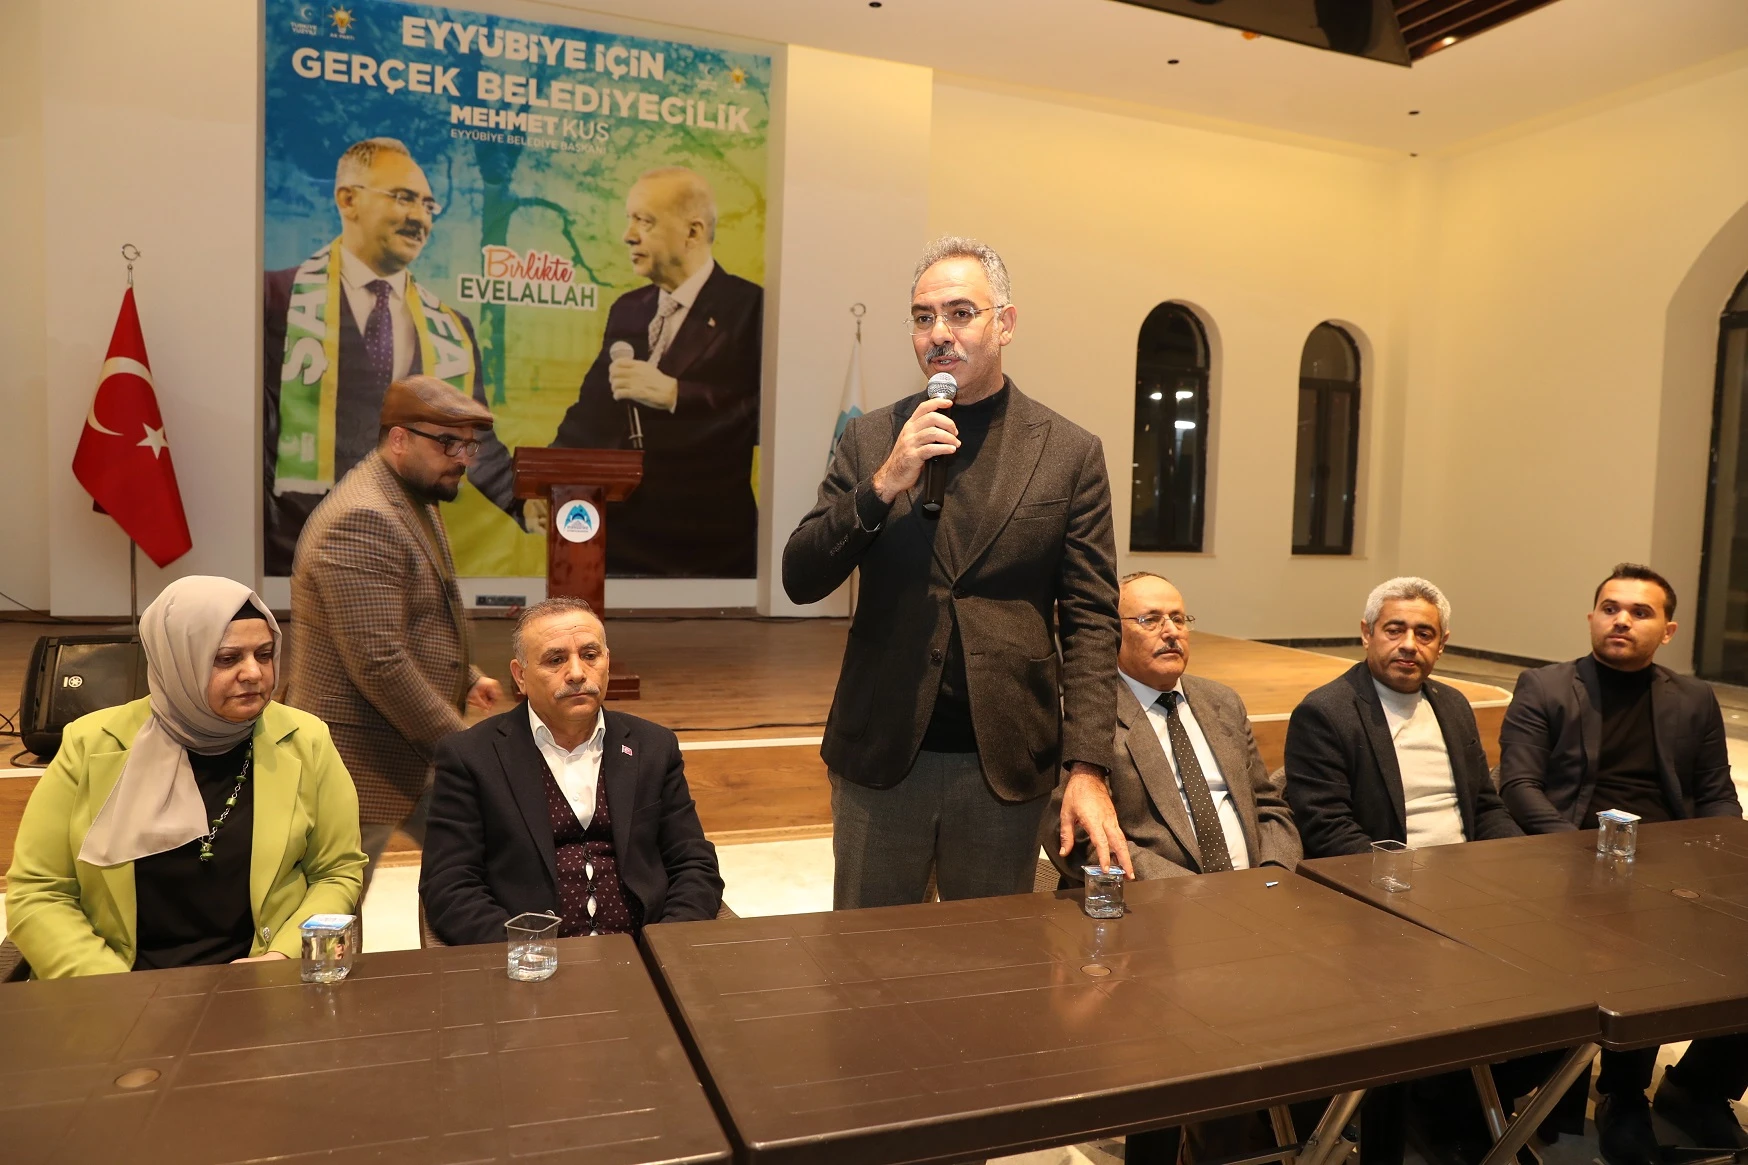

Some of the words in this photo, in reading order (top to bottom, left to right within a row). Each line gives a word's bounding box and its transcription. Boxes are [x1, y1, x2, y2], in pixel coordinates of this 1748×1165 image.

[402, 15, 587, 69] EYYÜBİYE
[595, 43, 665, 81] İÇİN
[291, 47, 461, 97] GERÇEK
[477, 71, 751, 133] BELEDİYECİLİK
[450, 105, 559, 135] MEHMET
[485, 248, 573, 283] Birlikte
[460, 277, 594, 307] EVELALLAH
